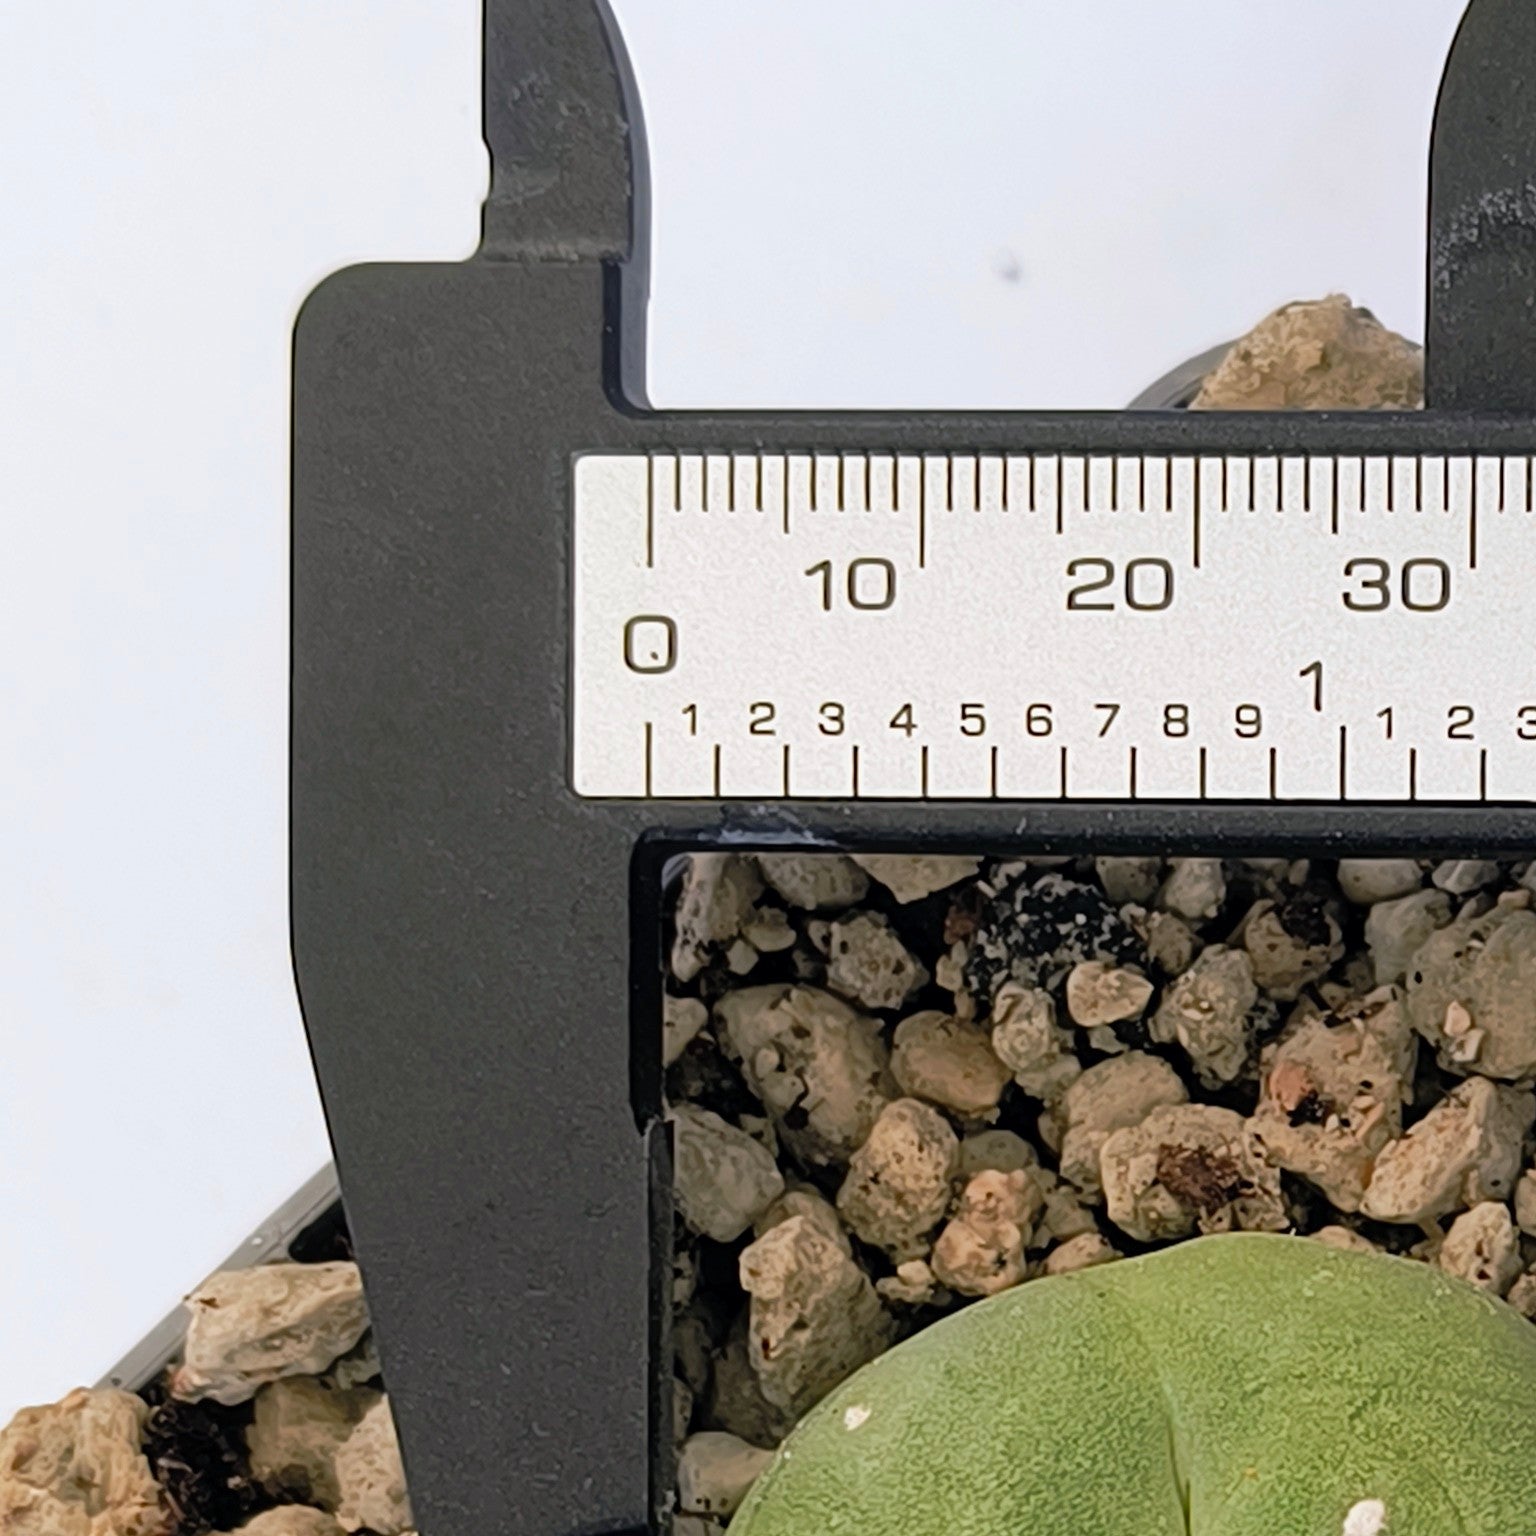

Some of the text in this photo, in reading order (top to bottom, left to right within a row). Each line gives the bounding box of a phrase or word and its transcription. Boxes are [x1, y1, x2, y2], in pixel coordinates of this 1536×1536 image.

[805, 558, 896, 613] 10
[1066, 558, 1174, 613] 20
[1342, 558, 1451, 614] 30
[623, 615, 677, 674] 0
[683, 703, 697, 735] 1
[749, 702, 775, 736] 2
[818, 702, 845, 737] 3
[889, 702, 917, 737] 4
[960, 702, 986, 737] 5
[1026, 702, 1053, 737] 6
[1095, 702, 1120, 738] 7
[1163, 702, 1189, 739] 8
[1235, 703, 1262, 740] 9
[1299, 661, 1322, 712] 1
[1378, 706, 1393, 740] 1
[1447, 705, 1474, 740] 2
